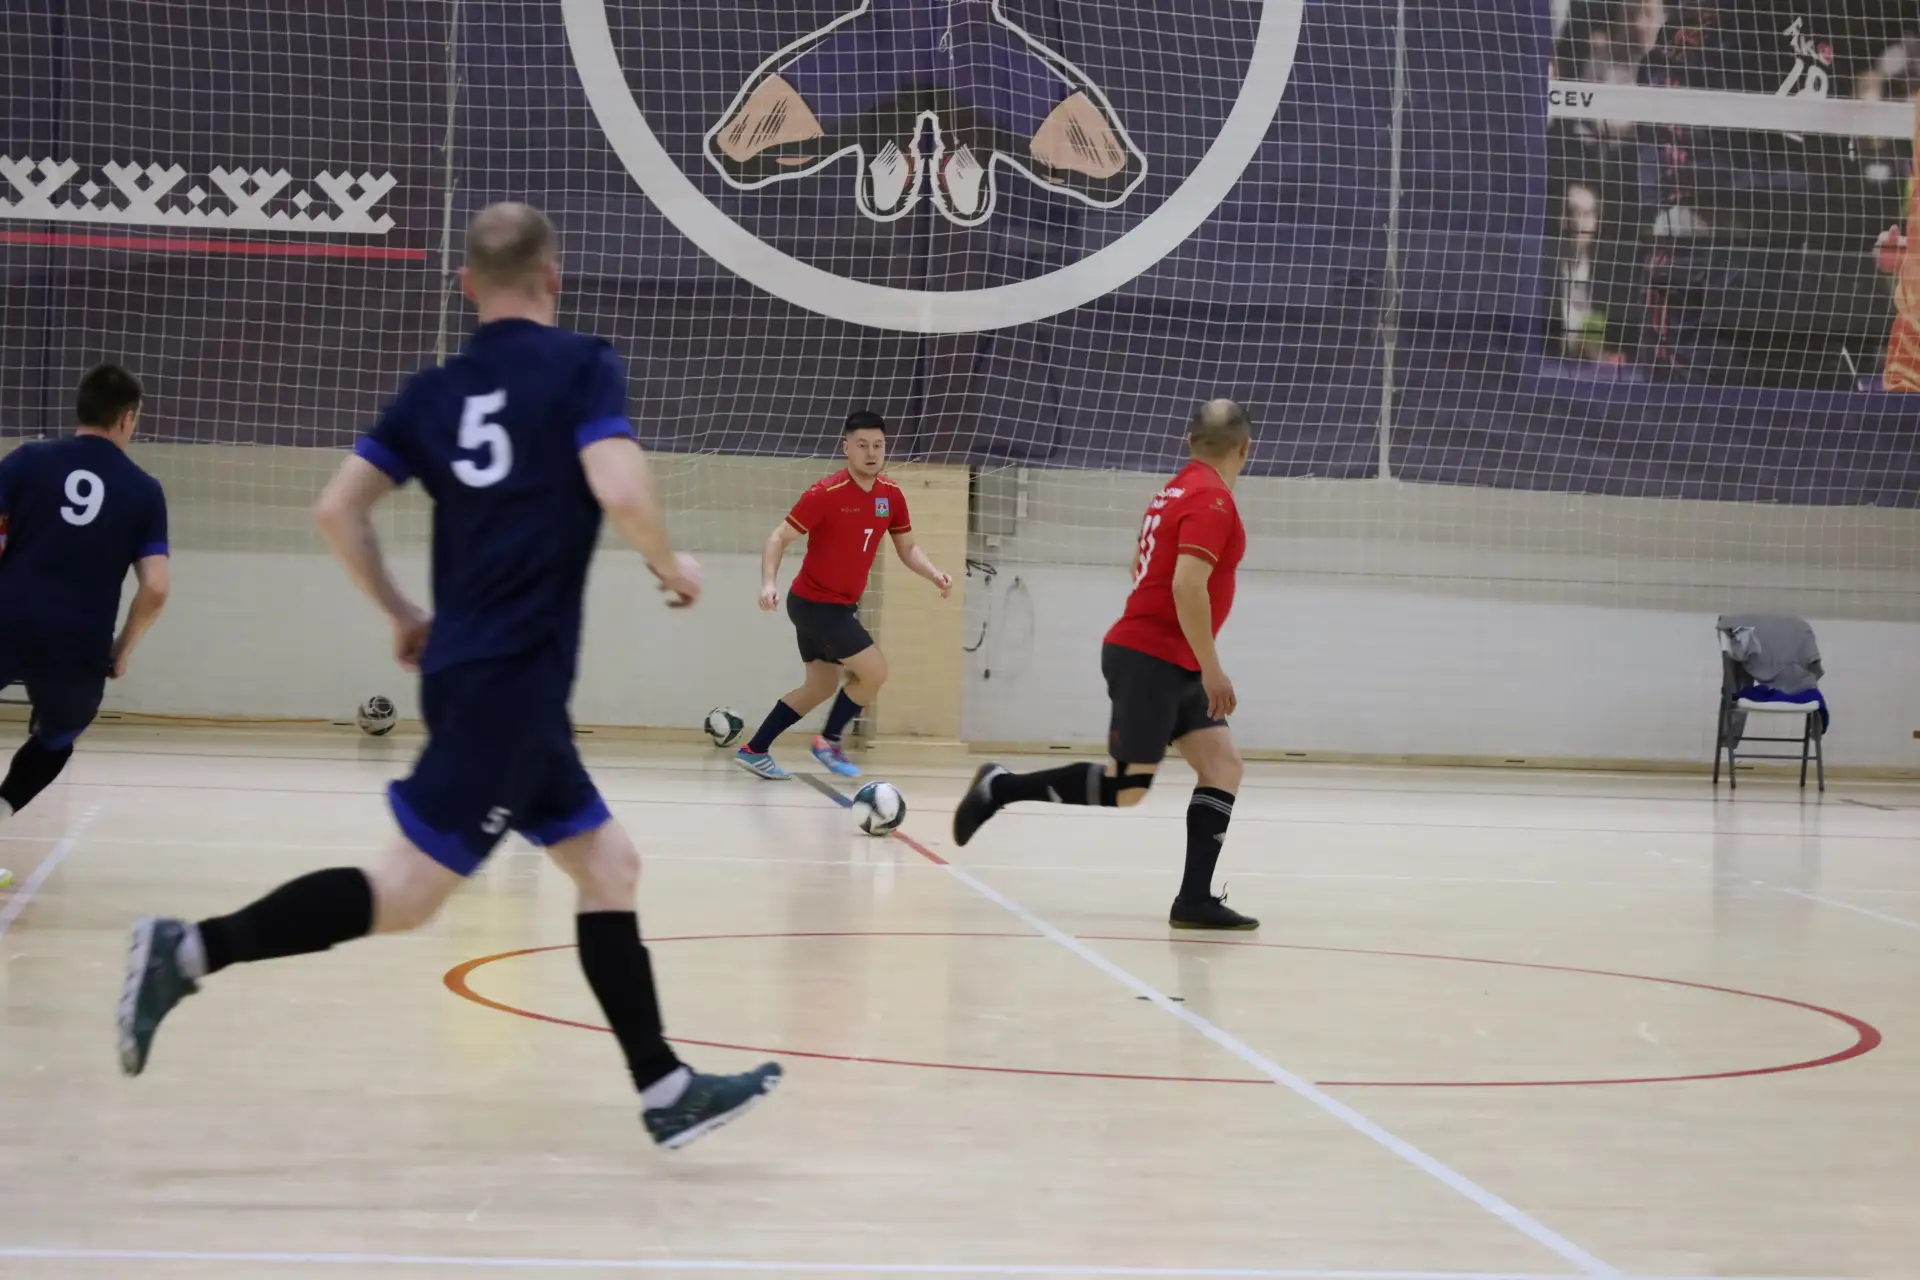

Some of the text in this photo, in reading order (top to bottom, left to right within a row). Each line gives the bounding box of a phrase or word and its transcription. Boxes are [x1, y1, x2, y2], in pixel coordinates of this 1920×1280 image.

[1549, 90, 1594, 107] CEV
[450, 387, 514, 489] 5
[60, 468, 105, 527] 9
[863, 528, 874, 553] 7
[480, 805, 513, 835] 5
